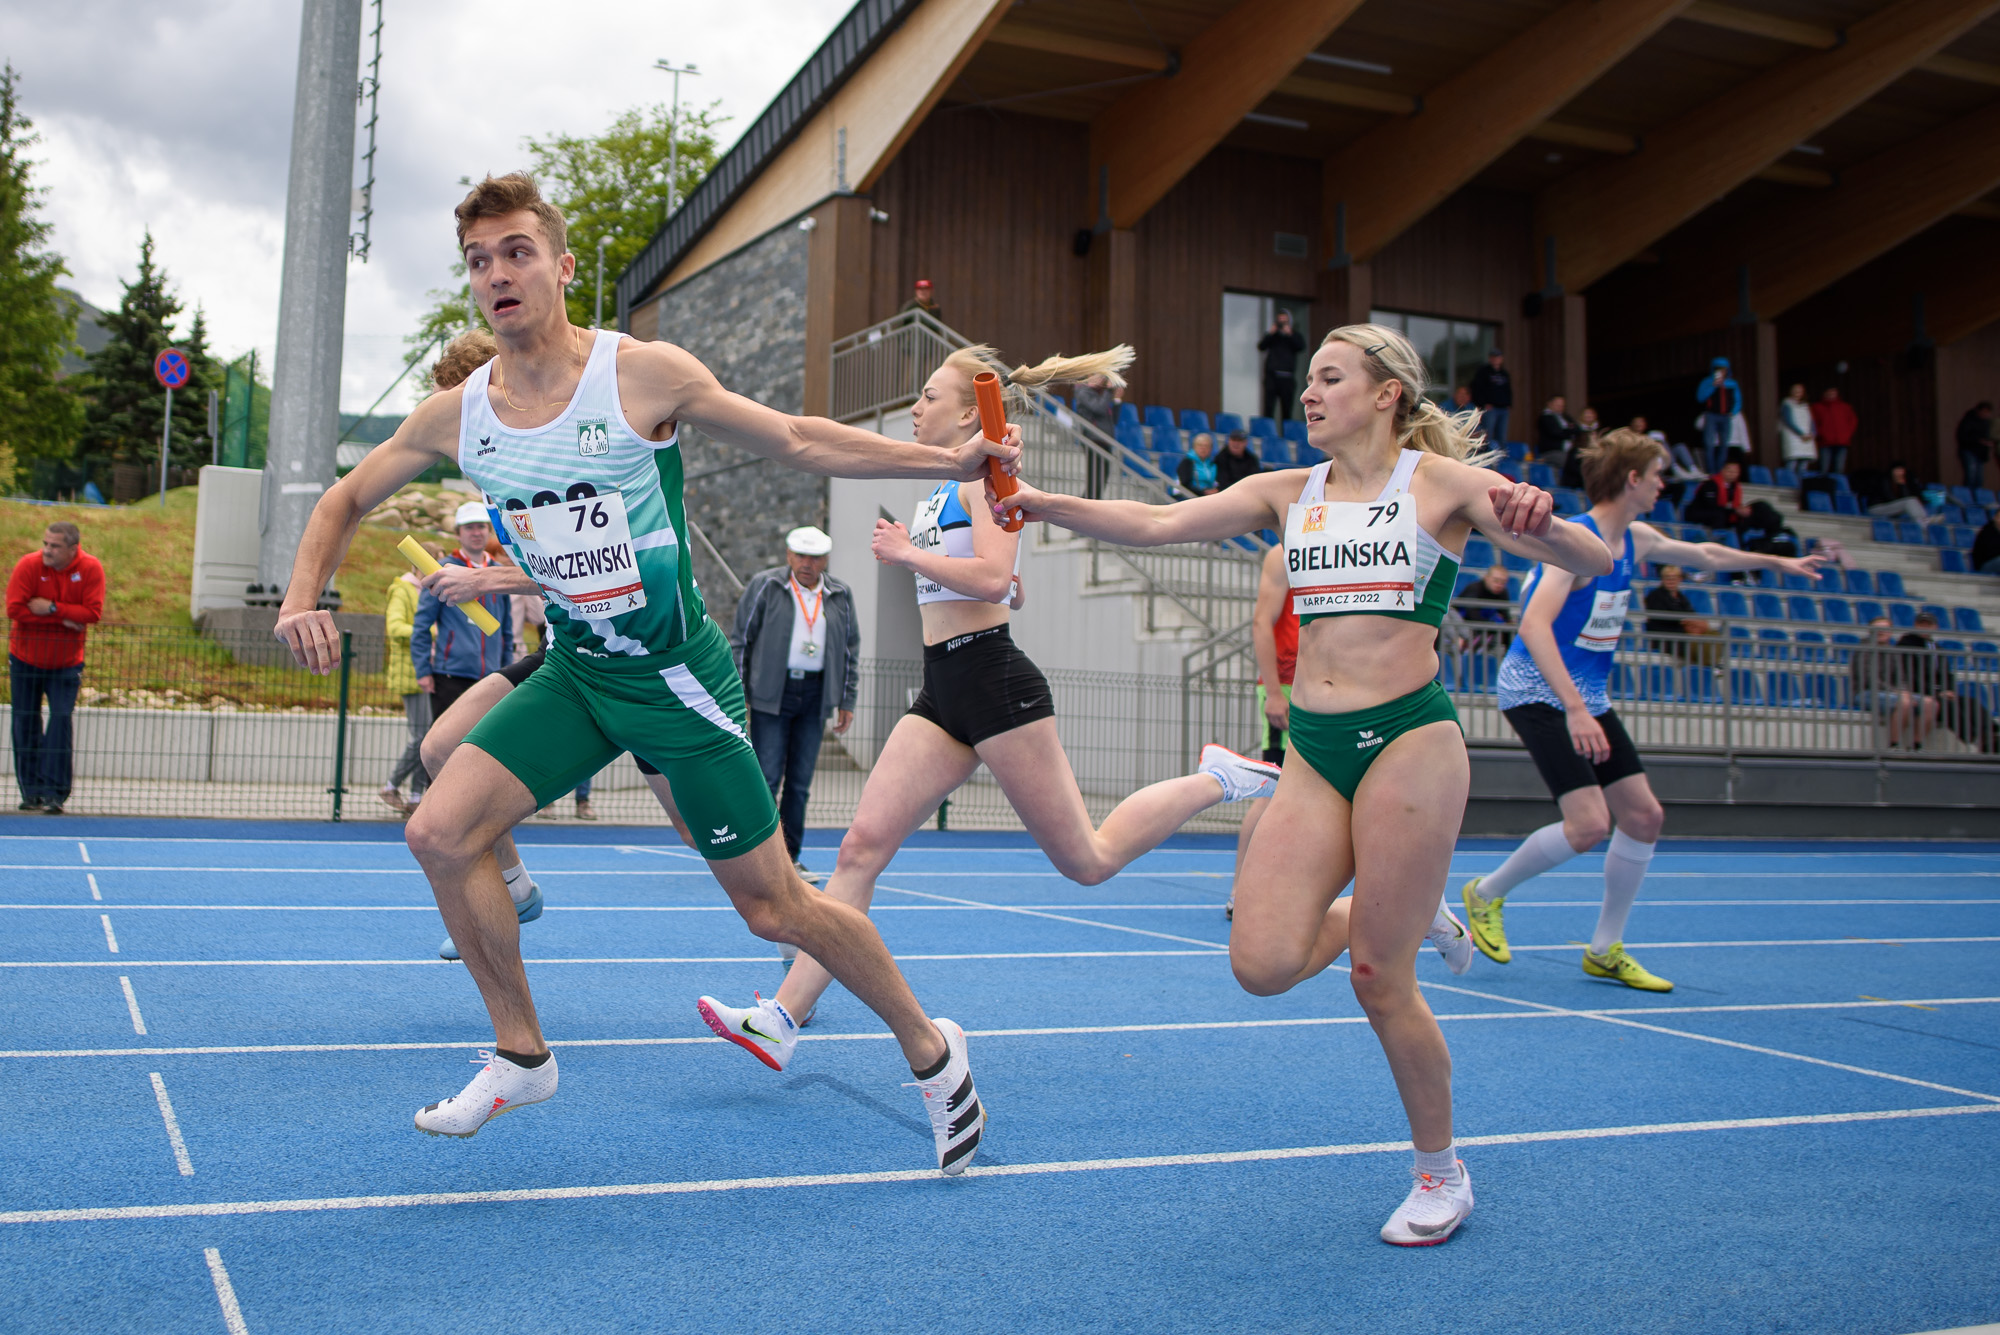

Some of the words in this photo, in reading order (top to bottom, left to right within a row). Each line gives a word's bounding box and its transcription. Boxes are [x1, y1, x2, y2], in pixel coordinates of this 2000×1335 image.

[576, 416, 607, 425] WARSZAWA
[477, 446, 496, 457] erima
[568, 501, 609, 532] 76
[1366, 501, 1400, 528] 79
[526, 542, 632, 581] ADAMCZEWSKI
[1288, 538, 1411, 573] BIELIŃSKA
[1303, 594, 1350, 607] KARPACZ
[1353, 593, 1380, 604] 2022
[584, 601, 612, 614] 2022
[710, 832, 738, 845] erima
